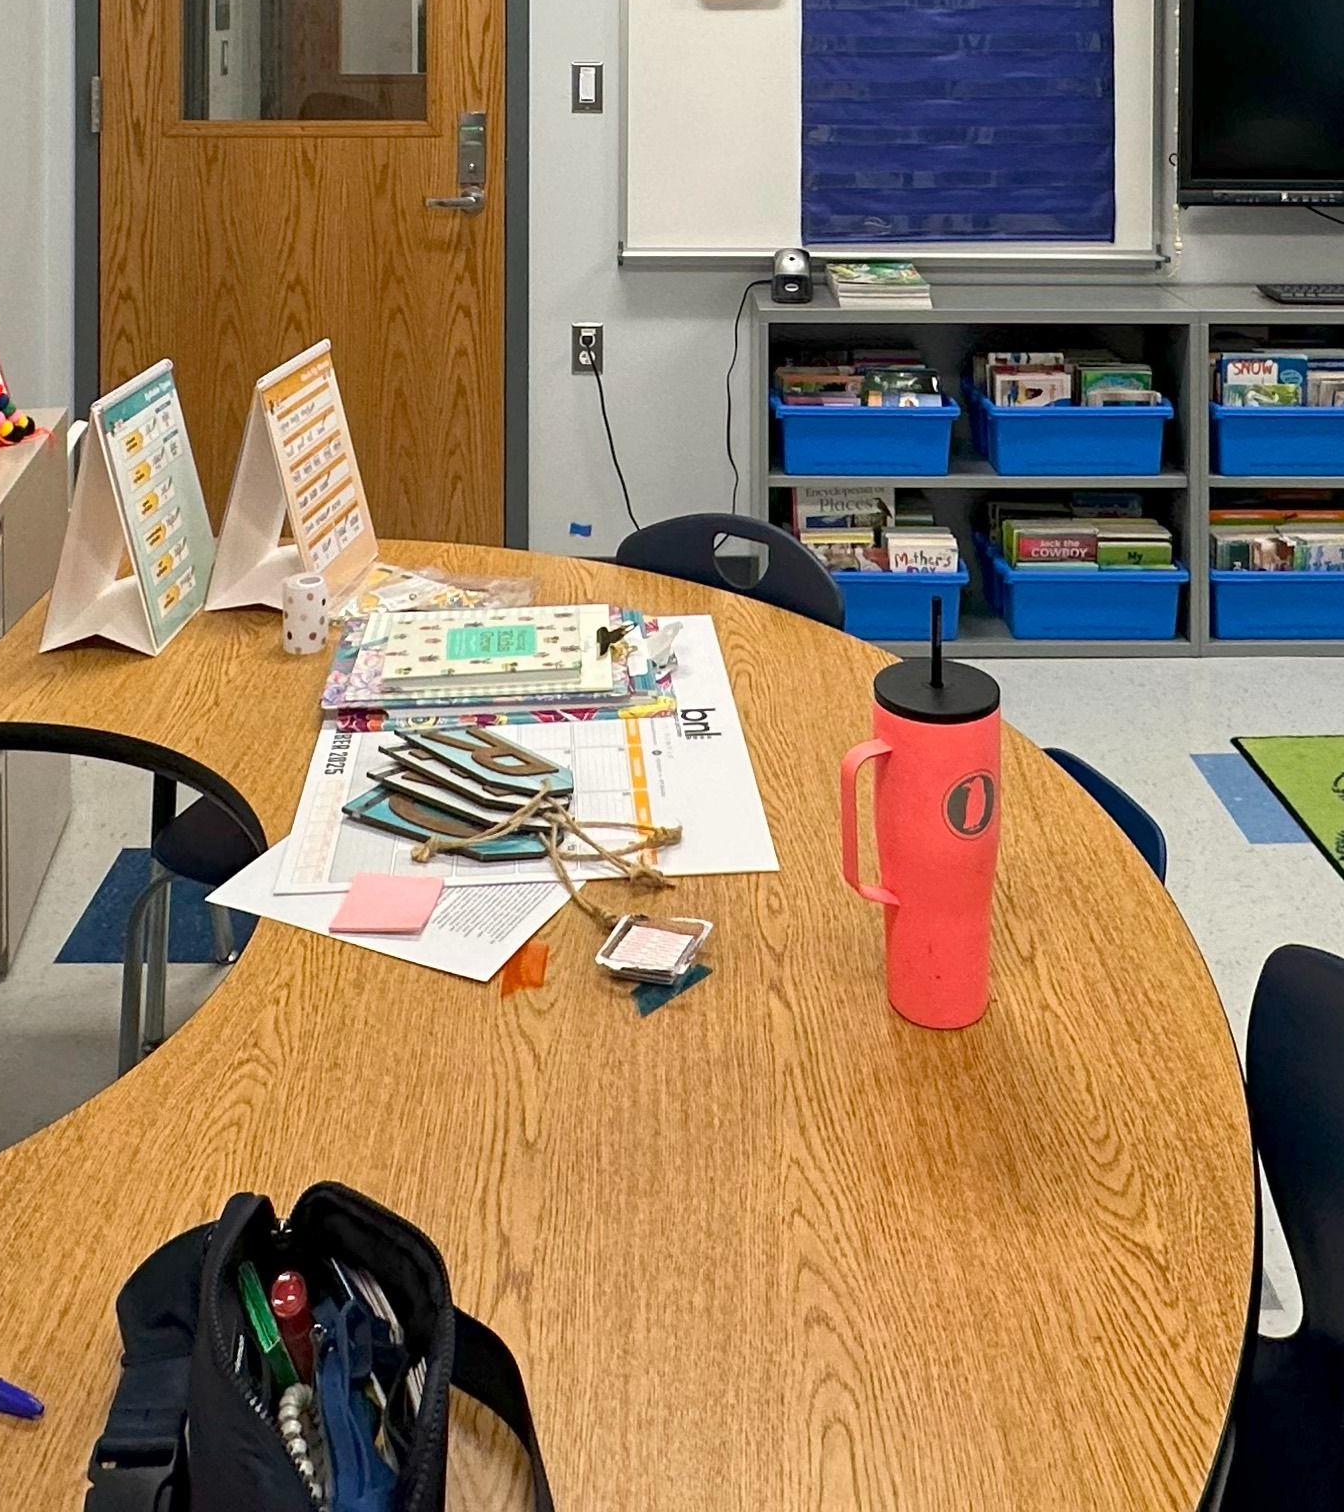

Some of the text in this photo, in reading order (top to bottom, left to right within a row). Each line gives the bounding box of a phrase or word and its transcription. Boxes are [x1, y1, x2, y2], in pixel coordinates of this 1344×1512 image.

[1233, 359, 1274, 376] SNOW
[819, 497, 874, 512] Places
[1063, 539, 1080, 548] the
[1030, 547, 1088, 558] COWBOY
[1127, 552, 1144, 563] My
[324, 751, 349, 775] 2025
